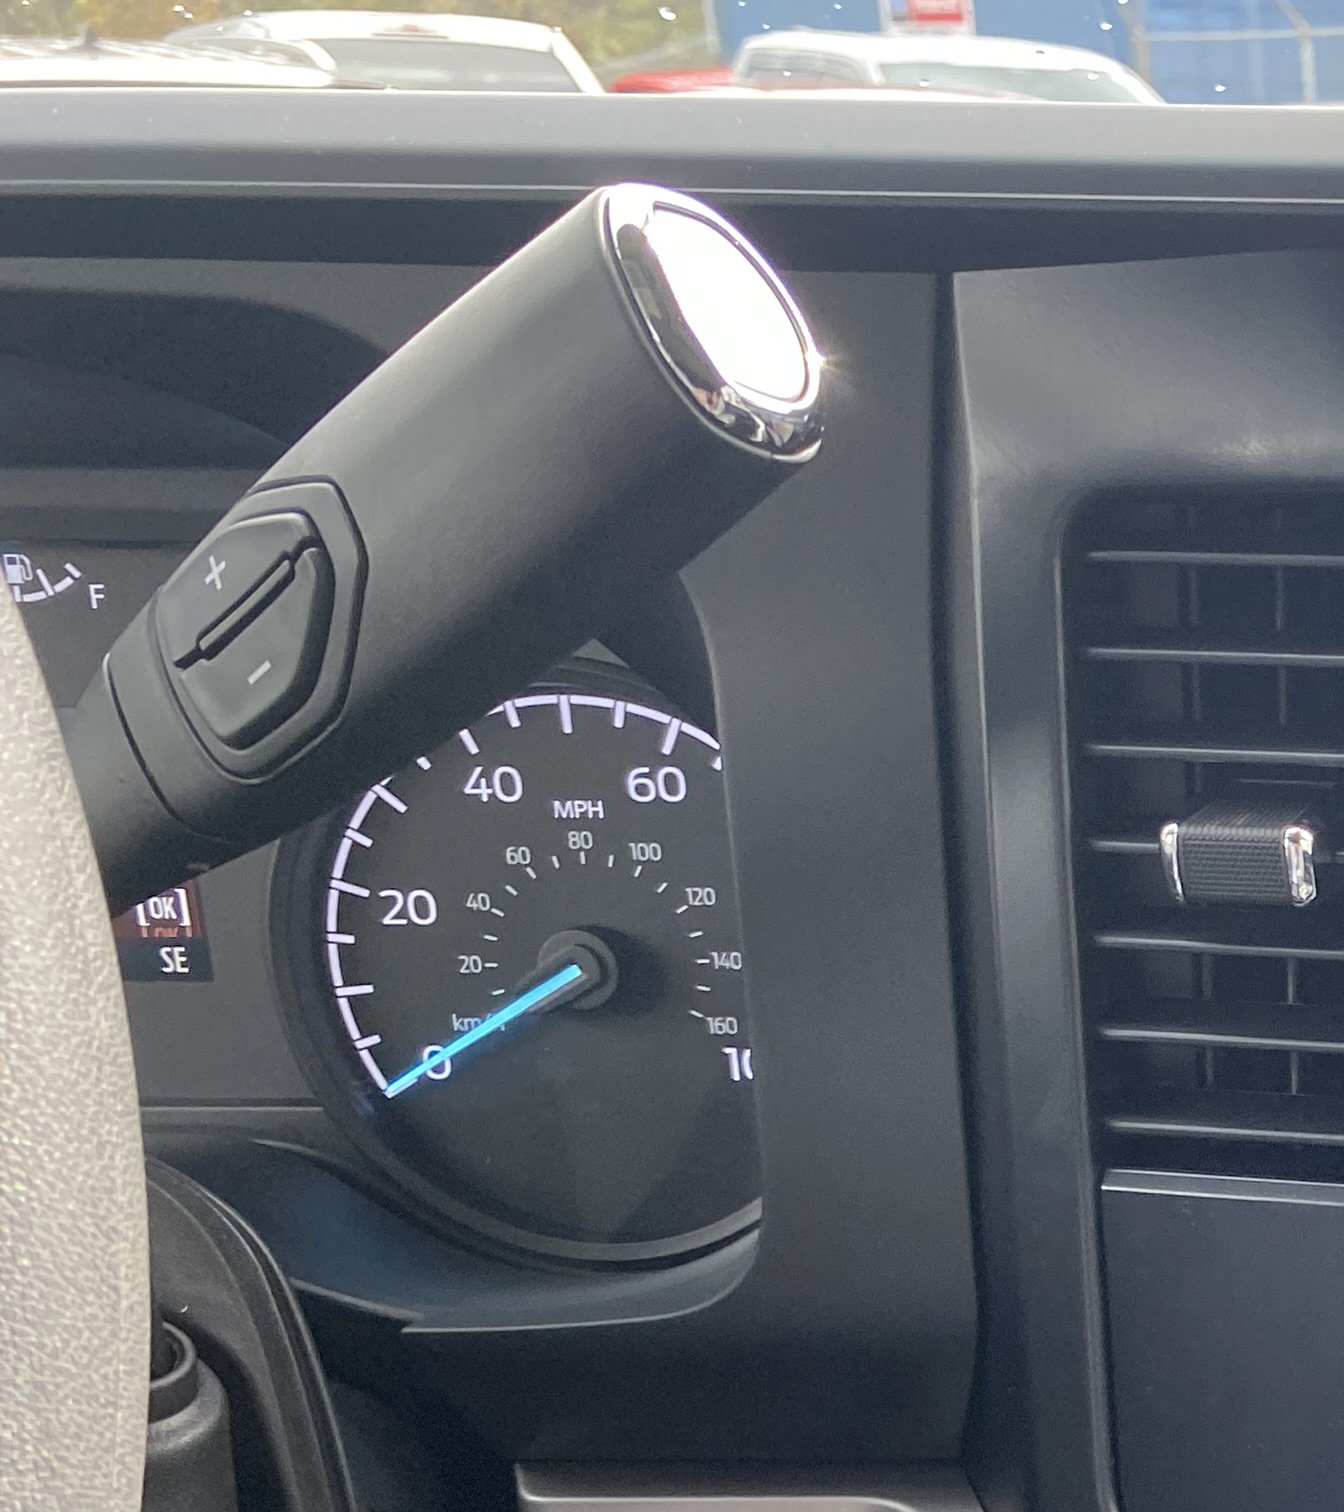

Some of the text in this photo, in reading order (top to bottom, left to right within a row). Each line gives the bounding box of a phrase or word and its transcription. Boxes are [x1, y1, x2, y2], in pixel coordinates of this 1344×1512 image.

[88, 584, 105, 609] F
[463, 765, 524, 803] 40
[626, 765, 687, 803] 60
[552, 800, 604, 819] MPH
[567, 831, 593, 850] 80
[505, 846, 531, 866] 60
[629, 842, 662, 862] 100
[465, 893, 491, 912] 40
[686, 887, 716, 907] 120
[378, 889, 438, 926] 20
[159, 946, 190, 973] SE
[457, 955, 483, 975] 20
[711, 951, 743, 970] 140
[706, 1017, 738, 1035] 160
